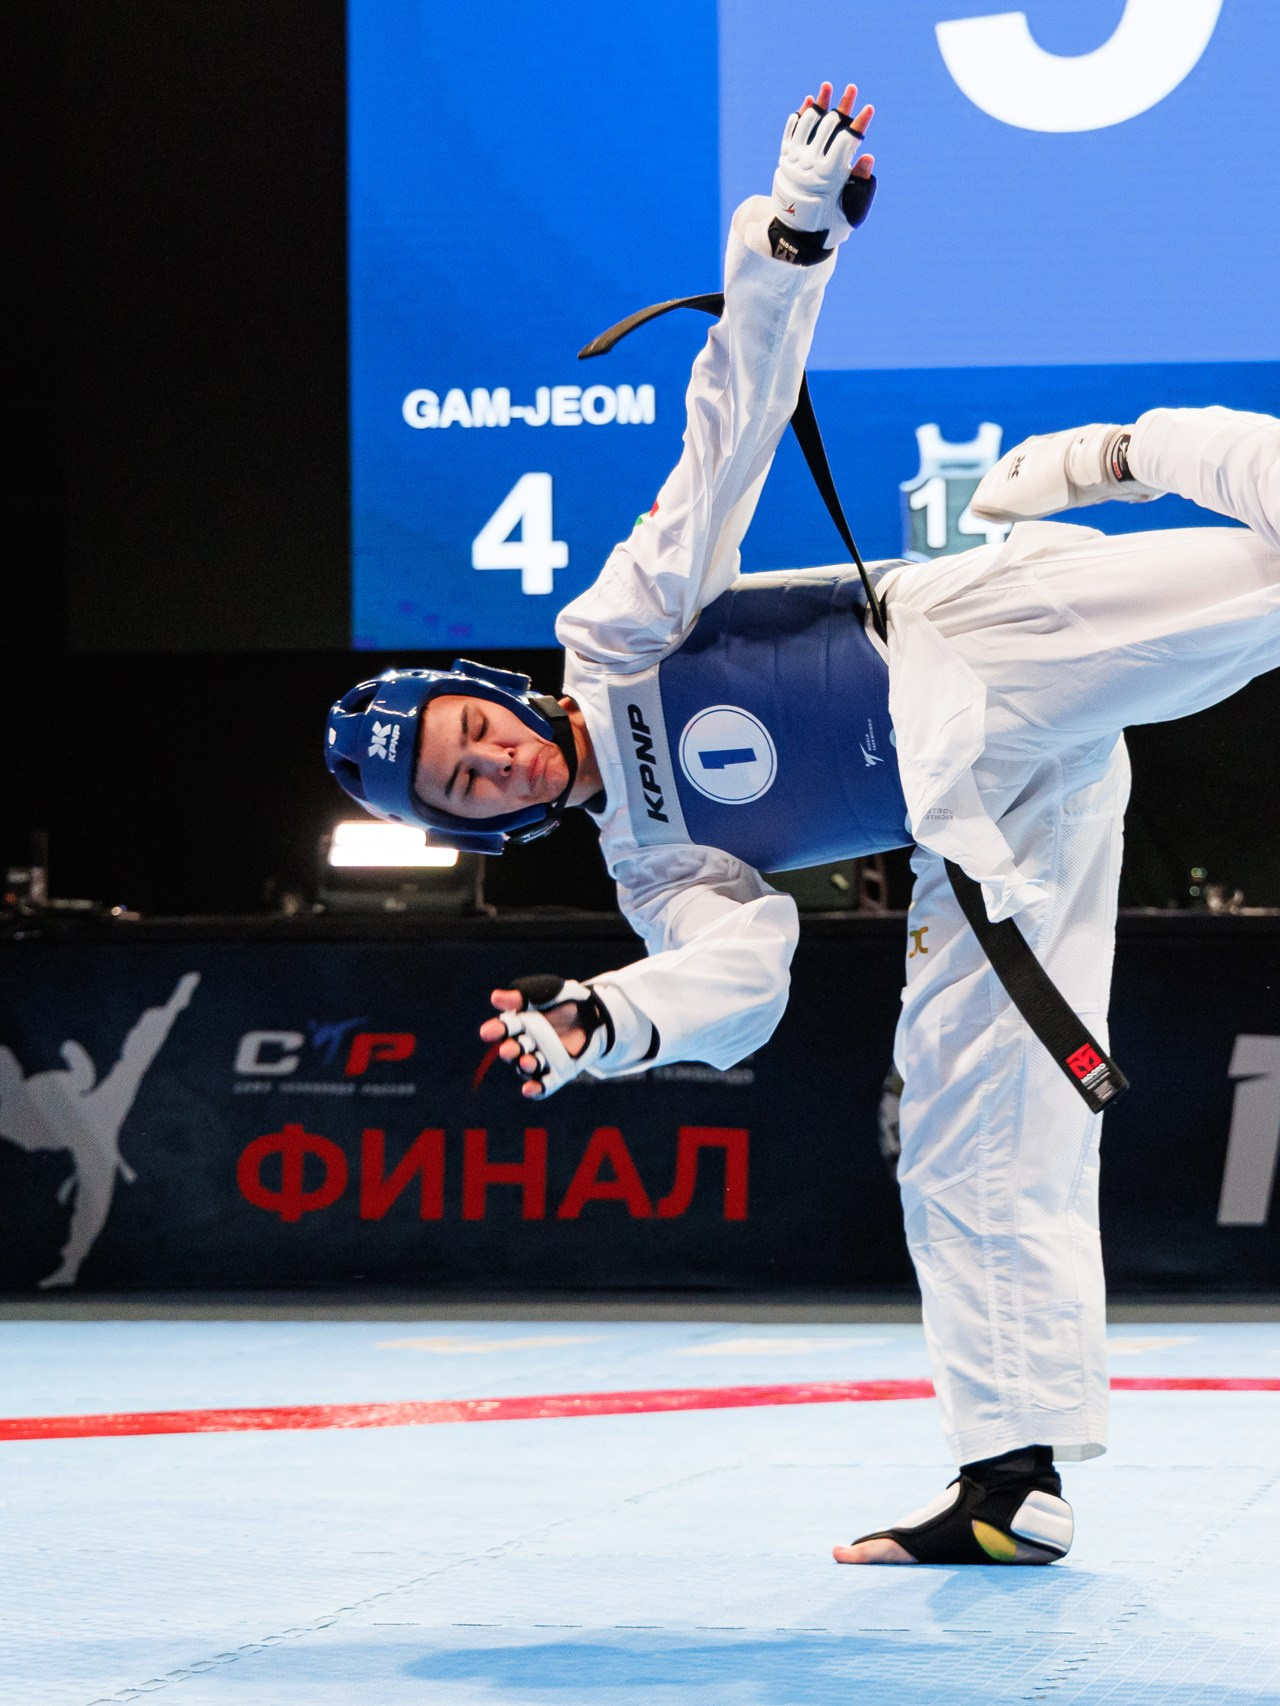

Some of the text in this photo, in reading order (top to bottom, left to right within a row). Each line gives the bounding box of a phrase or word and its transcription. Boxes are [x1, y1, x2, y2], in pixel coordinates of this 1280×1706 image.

[402, 384, 656, 429] GAM-JEOM
[471, 472, 569, 595] 4
[388, 724, 401, 762] KPNP
[628, 703, 669, 823] KPNP
[698, 747, 757, 770] 1
[235, 1123, 750, 1223] ФИНАЛ
